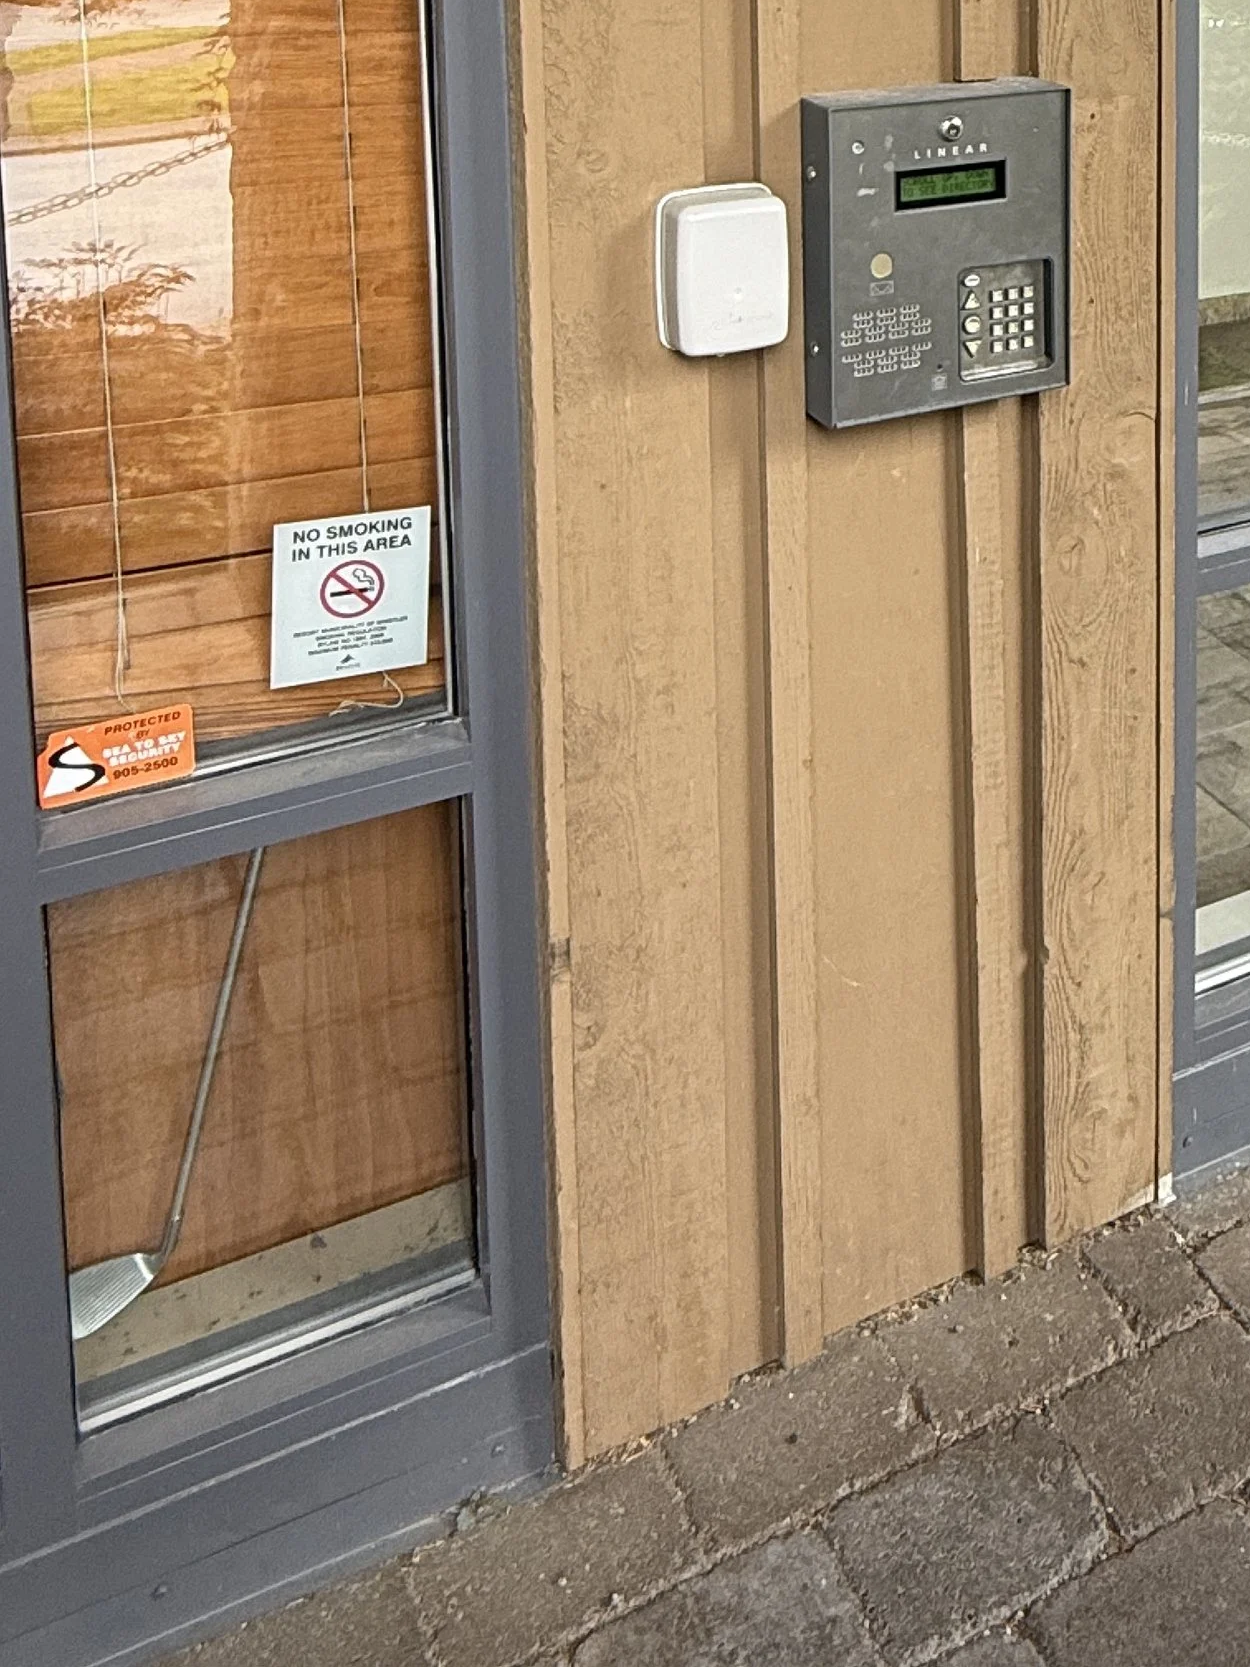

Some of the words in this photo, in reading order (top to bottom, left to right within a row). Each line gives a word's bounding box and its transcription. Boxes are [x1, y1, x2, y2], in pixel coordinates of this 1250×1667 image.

[914, 142, 988, 160] LINEAR
[293, 528, 320, 544] NO
[326, 516, 412, 540] SMOKING
[291, 547, 311, 562] IN
[316, 541, 358, 559] THIS
[363, 534, 412, 552] AREA
[104, 710, 181, 736] PROTECTED
[109, 741, 182, 767] SECURITY
[134, 738, 155, 751] TO
[112, 756, 179, 780] 905-2500
